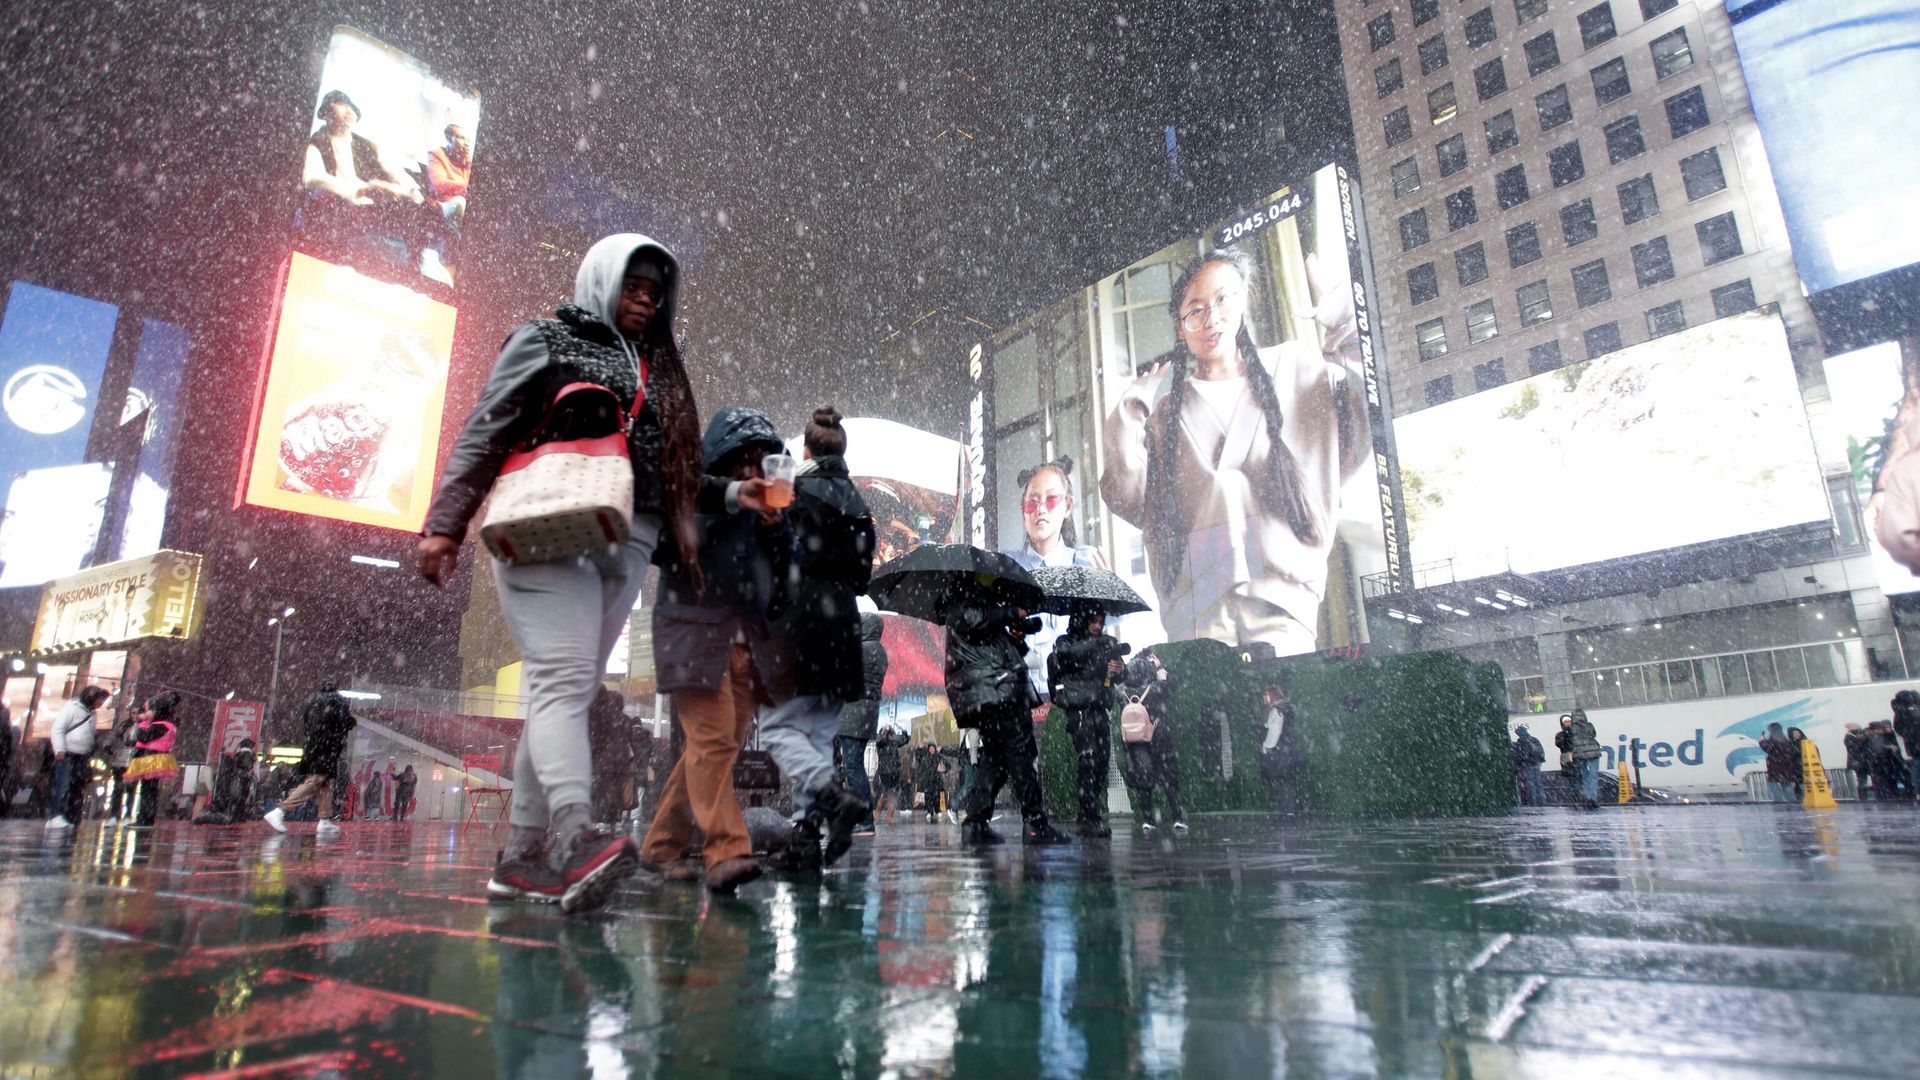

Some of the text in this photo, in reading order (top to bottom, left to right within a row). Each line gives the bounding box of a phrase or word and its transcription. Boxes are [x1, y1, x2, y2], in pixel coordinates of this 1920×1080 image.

[1222, 194, 1302, 243] 2045.044
[1353, 282, 1380, 407] GO TO TSX.LIVE
[1377, 453, 1388, 478] BE
[54, 580, 113, 608] MISSIONARY
[114, 573, 149, 594] STYLE
[1600, 729, 1704, 769] nited
